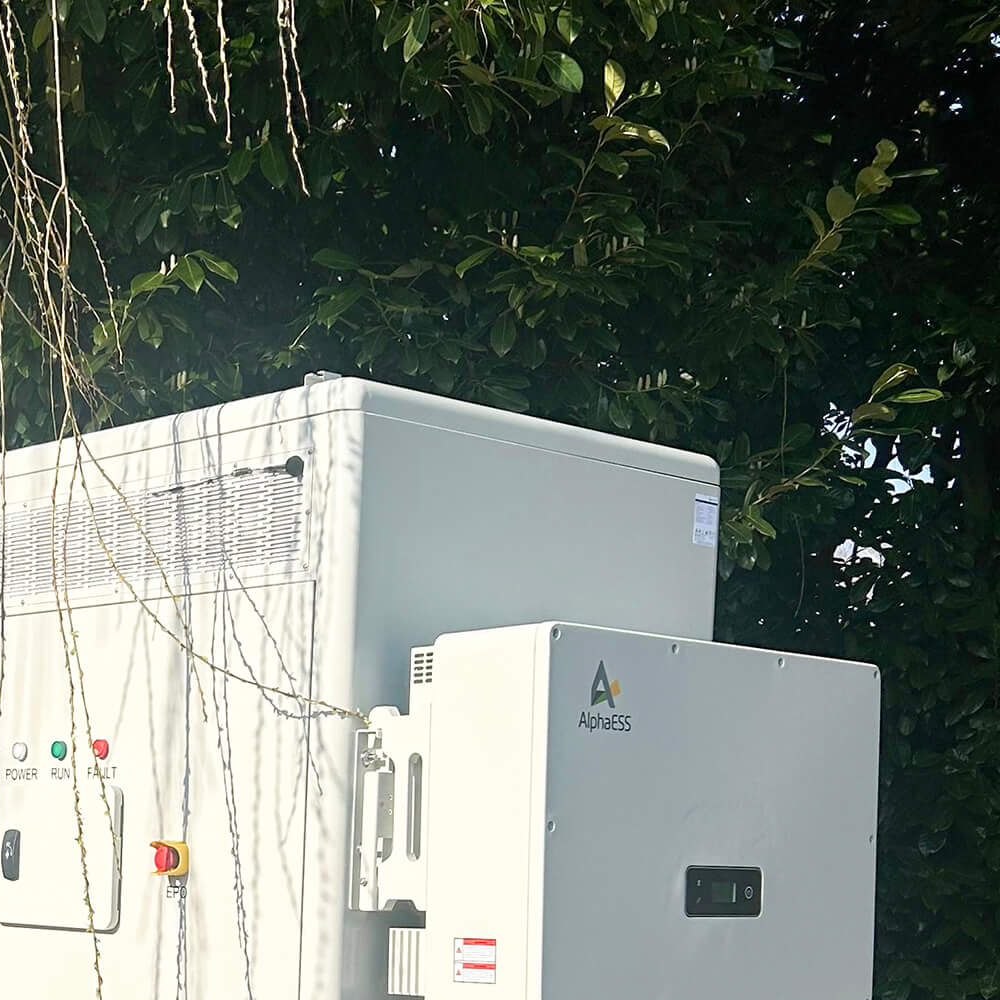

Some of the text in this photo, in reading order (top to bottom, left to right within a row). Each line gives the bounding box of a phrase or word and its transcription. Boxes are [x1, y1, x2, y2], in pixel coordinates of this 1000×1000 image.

[578, 711, 632, 733] AlphaESS
[5, 767, 38, 781] POWER
[50, 766, 71, 780] RUN
